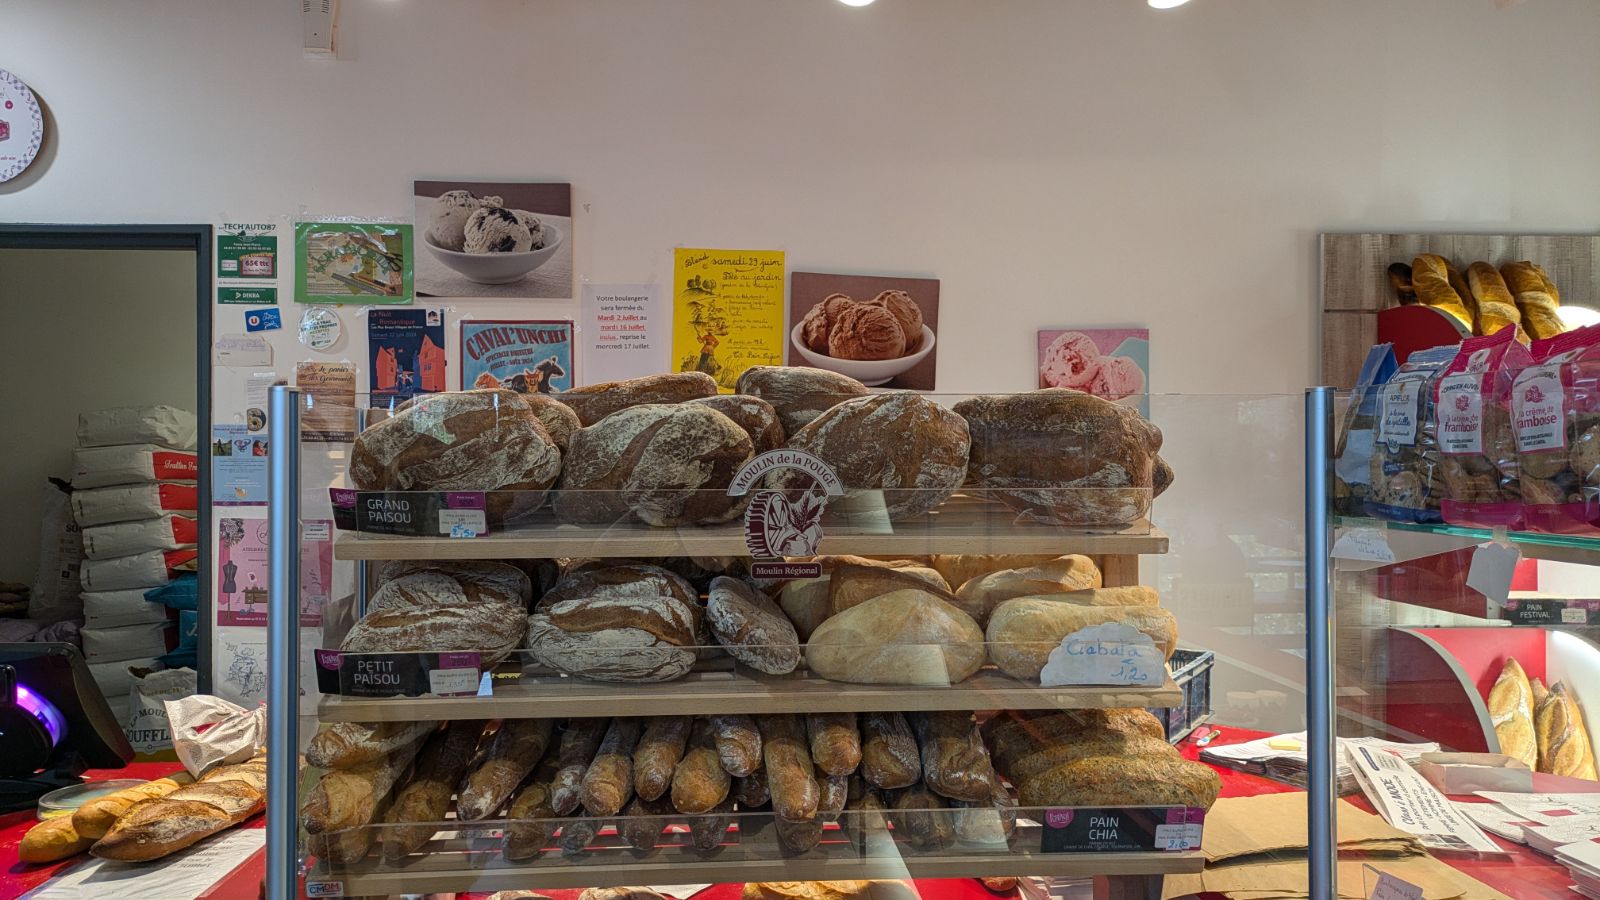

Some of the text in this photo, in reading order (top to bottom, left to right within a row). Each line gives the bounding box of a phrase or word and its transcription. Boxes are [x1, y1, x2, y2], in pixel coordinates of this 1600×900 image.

[711, 256, 747, 266] samedi
[760, 259, 782, 272] juin
[465, 327, 567, 360] CAVAL'UNCHI
[736, 453, 837, 490] MOULIN de la POUGE
[367, 499, 410, 511] GRAND
[756, 567, 818, 576] Moulin Régional
[1519, 612, 1551, 620] FESTIVAL
[357, 660, 395, 672] PETIT
[353, 671, 401, 685] PAÏSOU
[138, 708, 169, 719] MOUL
[127, 729, 172, 743] OUFFL
[1090, 816, 1119, 827] PAIN
[1089, 829, 1118, 840] CHIA
